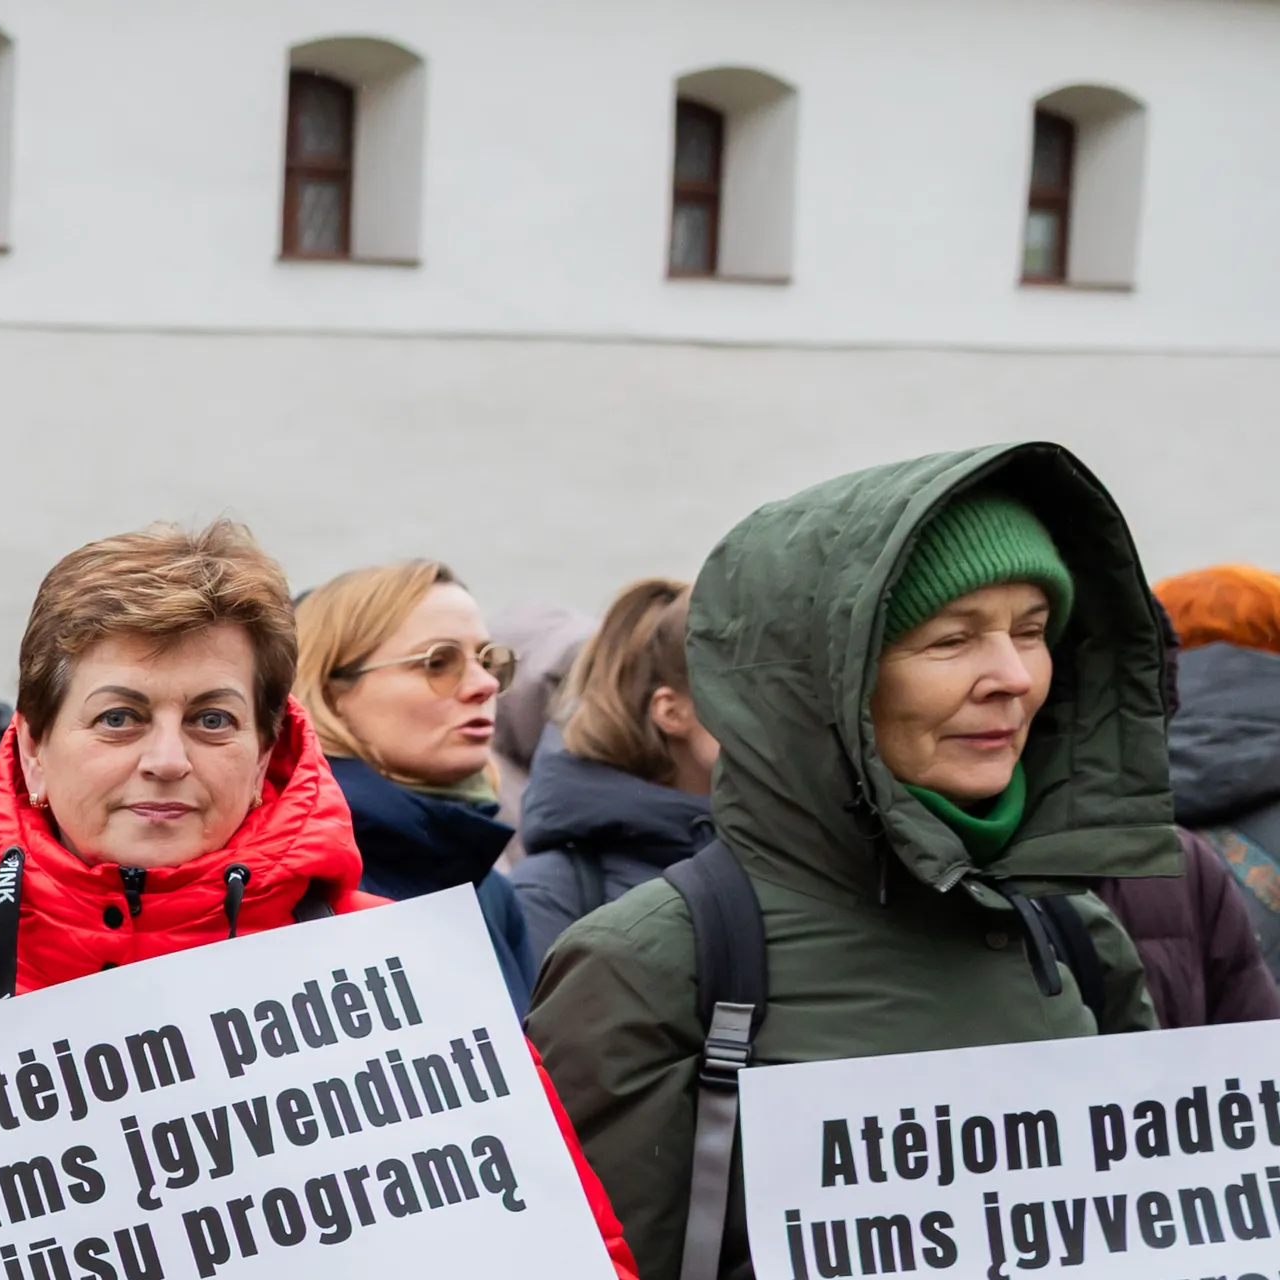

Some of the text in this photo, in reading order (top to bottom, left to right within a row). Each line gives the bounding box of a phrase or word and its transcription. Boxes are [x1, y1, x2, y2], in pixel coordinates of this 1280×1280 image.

[209, 956, 423, 1079] padėti
[120, 1027, 510, 1211] įgyvendinti
[821, 1104, 1062, 1188] Atėjom
[181, 1135, 527, 1279] programą
